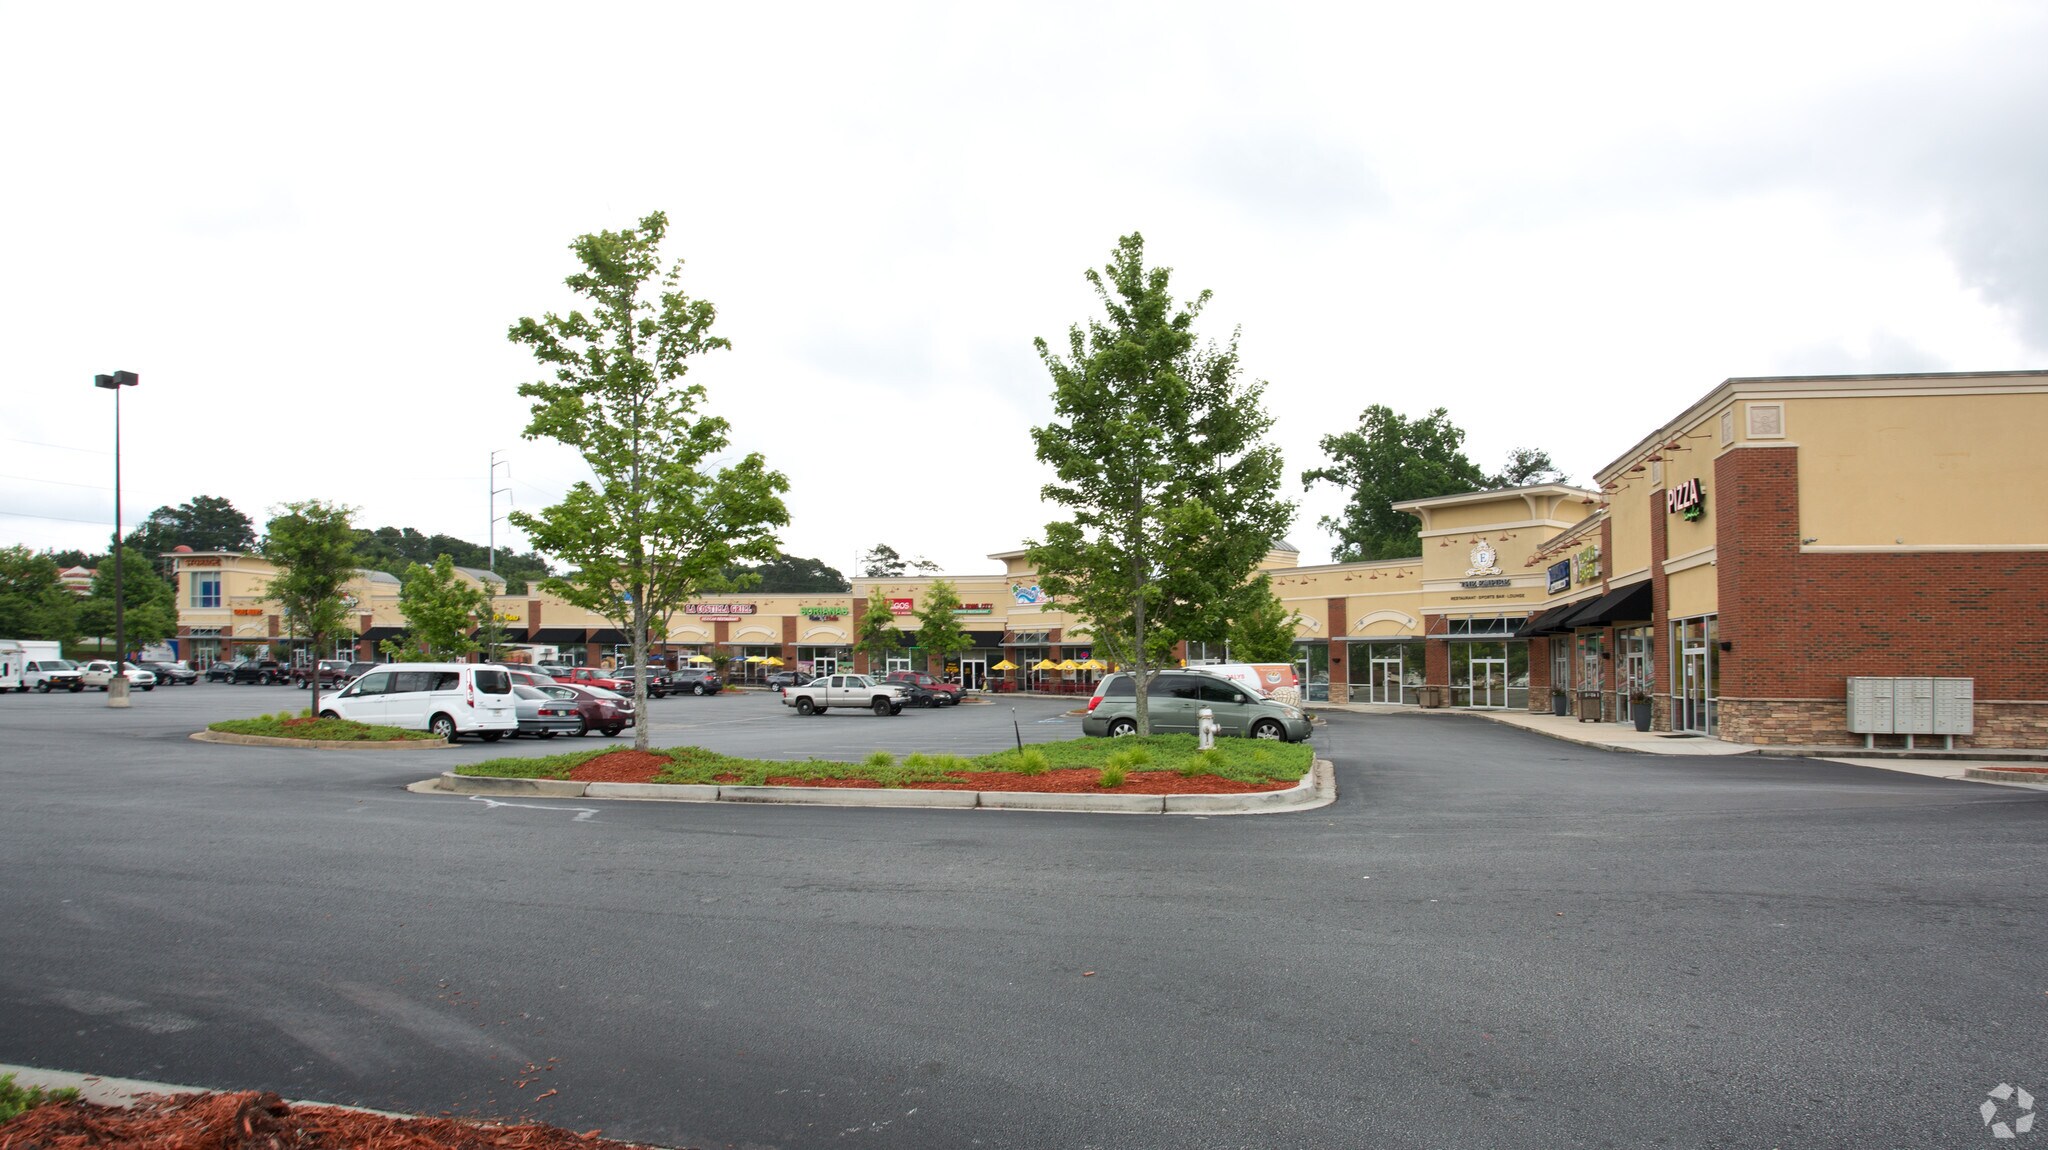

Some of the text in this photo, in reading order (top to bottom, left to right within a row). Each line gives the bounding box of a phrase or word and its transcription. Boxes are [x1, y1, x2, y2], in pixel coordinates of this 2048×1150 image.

[1667, 478, 1700, 514] PIZZA
[1480, 553, 1487, 563] E
[685, 604, 753, 614] LA COSTILLA GRILL
[800, 606, 849, 616] SORIANAS
